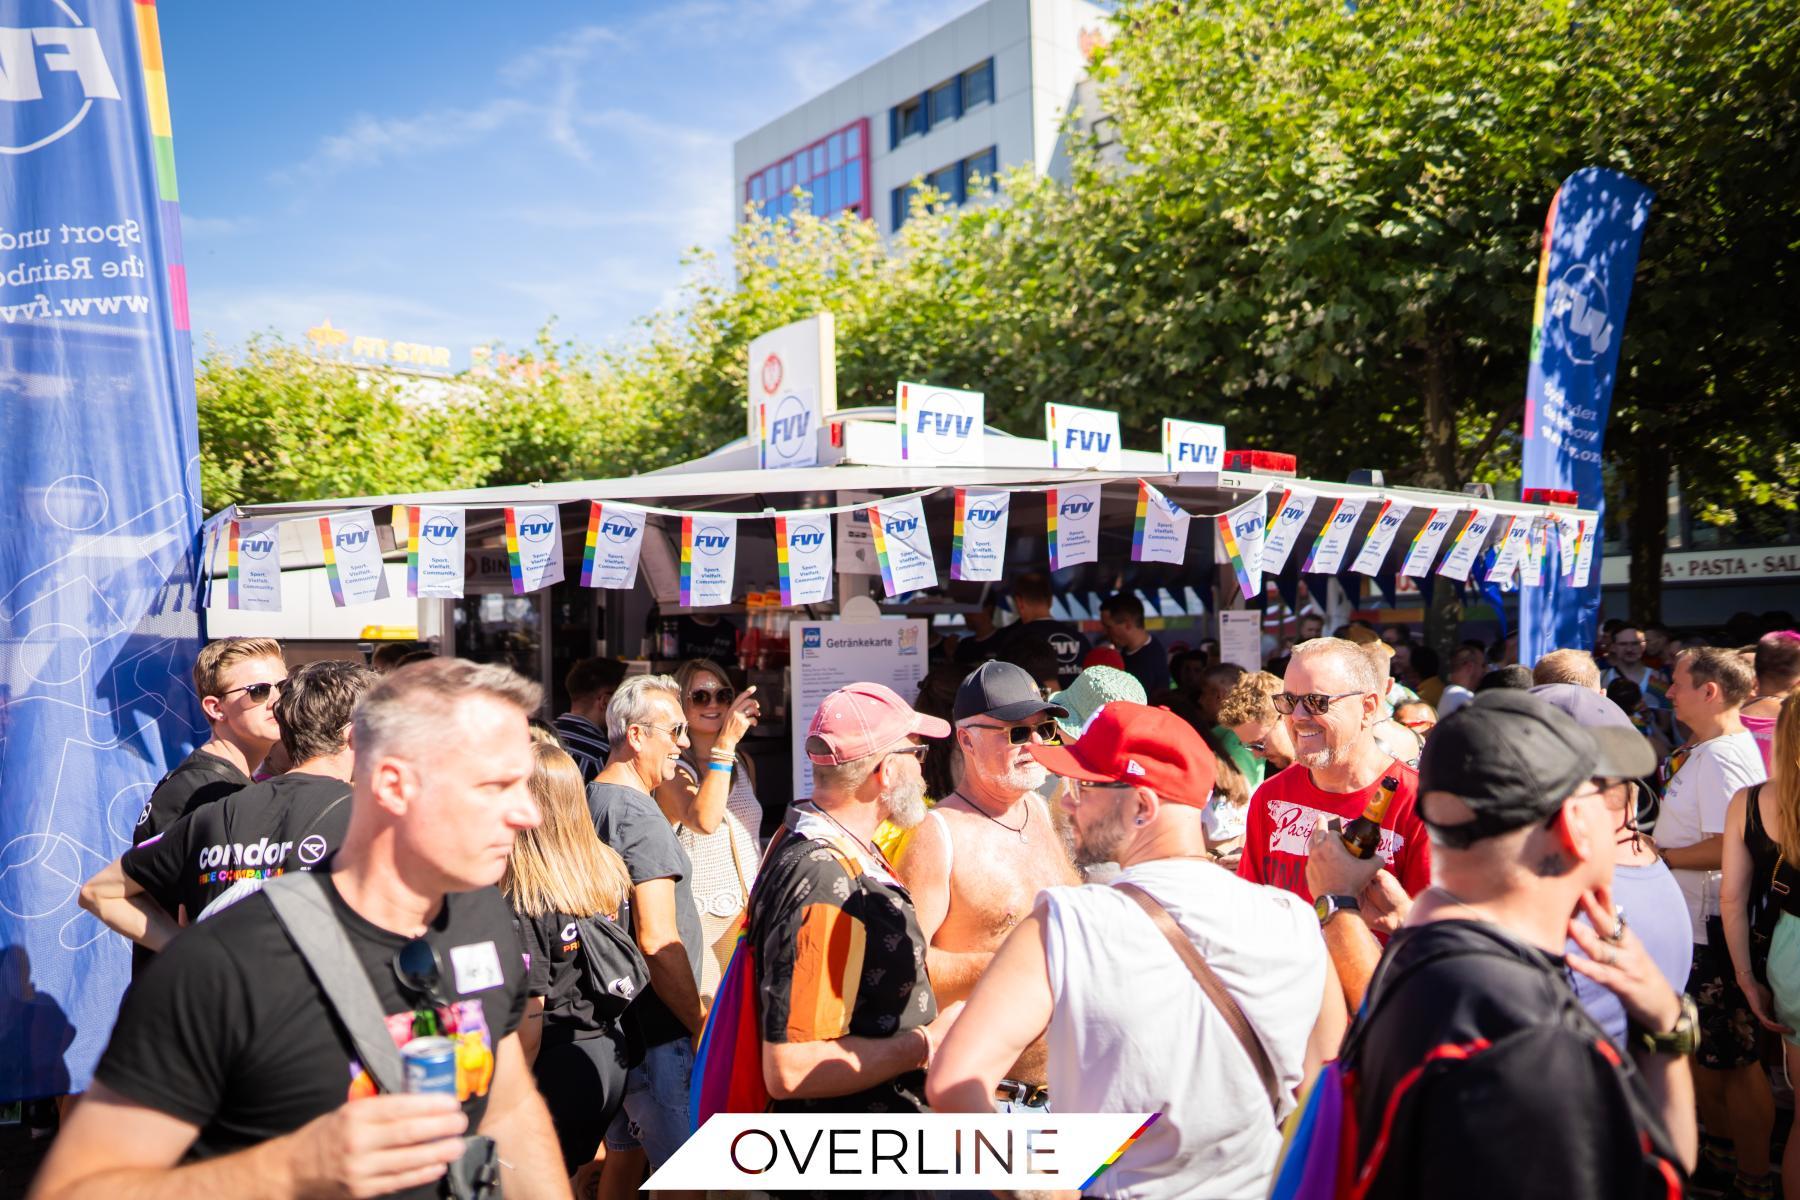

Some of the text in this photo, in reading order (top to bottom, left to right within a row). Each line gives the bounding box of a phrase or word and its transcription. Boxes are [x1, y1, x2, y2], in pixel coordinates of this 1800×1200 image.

[771, 410, 811, 445] FVV
[916, 410, 974, 438] FVV
[1065, 428, 1111, 453] FVV
[1178, 442, 1217, 465] FVV
[967, 509, 1002, 522] FVV
[1060, 502, 1094, 515] FVV
[1281, 506, 1305, 520] FVV
[886, 517, 918, 534] FVV
[1334, 513, 1356, 524] FVV
[1380, 515, 1400, 527] FVV
[422, 525, 458, 538] FVV
[520, 522, 553, 536] FVV
[601, 522, 638, 538] FVV
[1428, 521, 1447, 531] FVV
[336, 530, 369, 547] FVV
[695, 535, 730, 548] FVV
[790, 533, 825, 546] FVV
[241, 540, 274, 552] FVV
[1688, 558, 1747, 576] PASTA
[826, 638, 893, 648] Getränkekarte
[199, 837, 293, 870] condor
